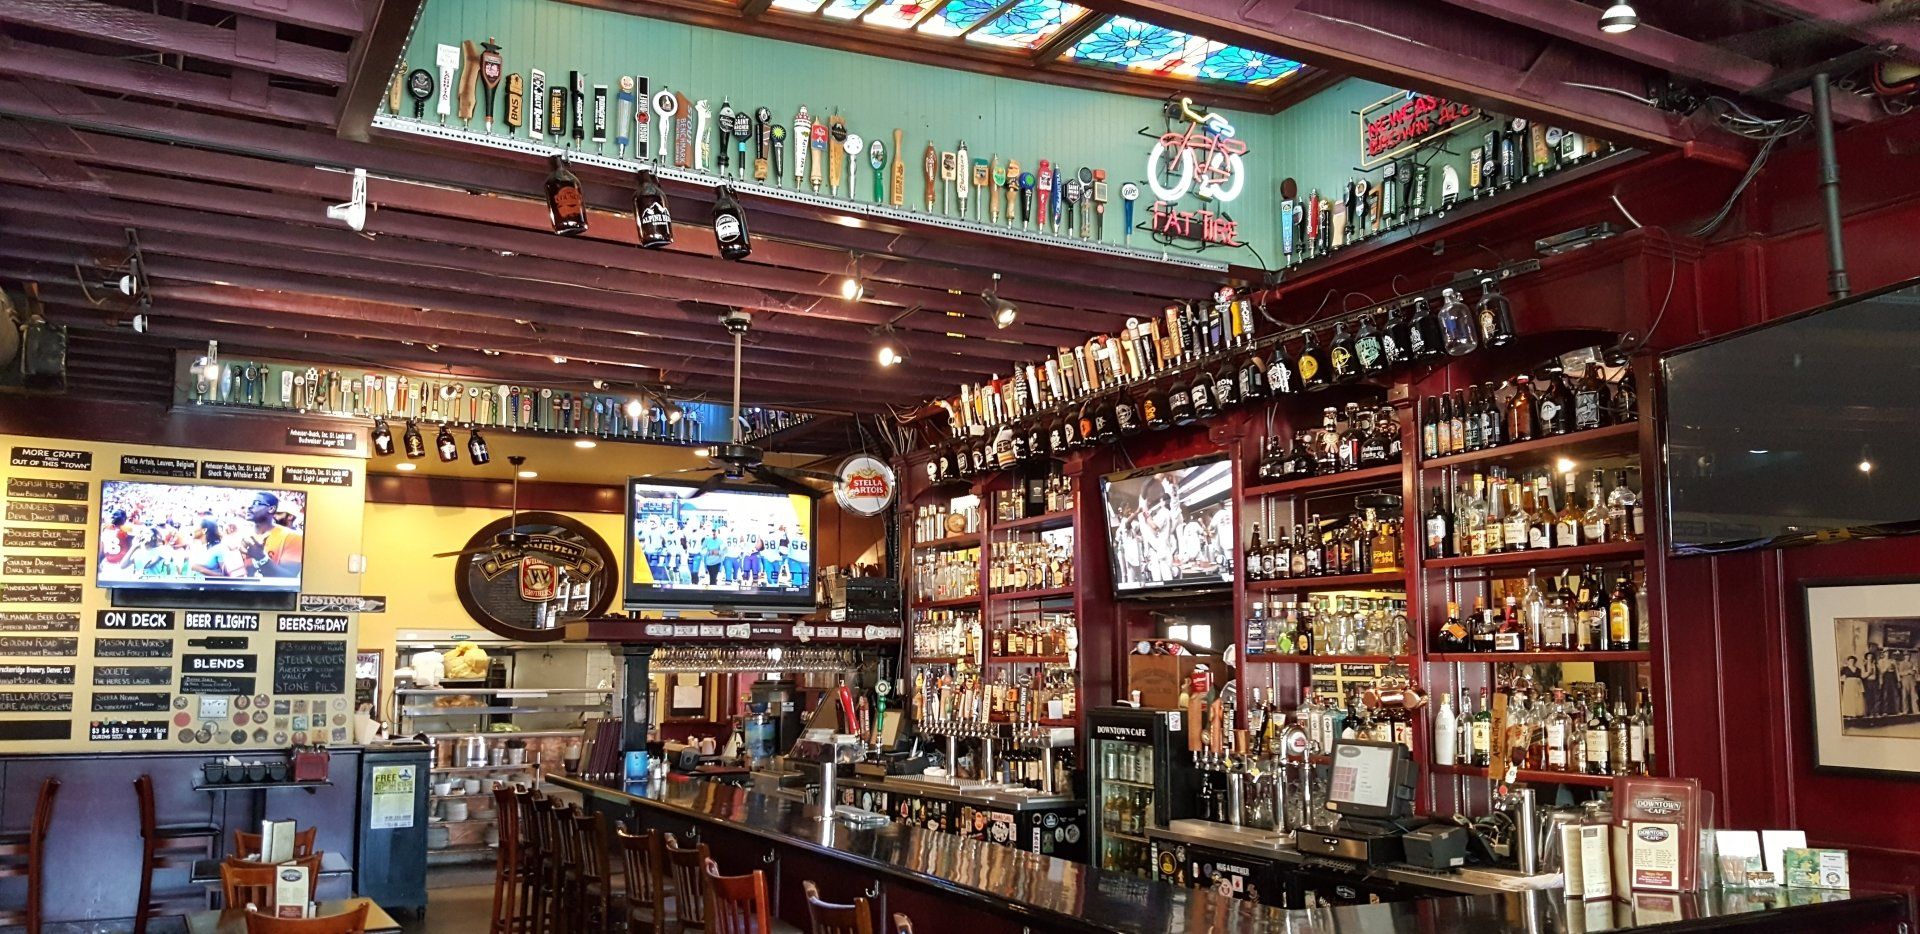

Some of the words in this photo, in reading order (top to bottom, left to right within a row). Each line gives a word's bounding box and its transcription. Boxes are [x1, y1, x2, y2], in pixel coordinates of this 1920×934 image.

[1368, 95, 1446, 138] NEWCAS
[643, 214, 662, 225] ALPINE
[1154, 200, 1194, 236] FAT
[1197, 210, 1242, 246] TIRE
[299, 437, 321, 445] Budweiser
[322, 439, 336, 447] Lager
[22, 449, 49, 457] MORE
[52, 451, 82, 459] CRAFT
[139, 458, 155, 466] Artois,
[157, 459, 175, 467] Leuven,
[176, 460, 195, 469] Belgium
[303, 475, 315, 484] Light
[316, 476, 329, 484] Lager
[855, 486, 884, 494] ARTOIS
[10, 502, 54, 511] FOUNDERS
[791, 541, 807, 550] 68
[301, 596, 363, 605] RESTROOMS
[104, 612, 126, 626] ON
[131, 613, 167, 627] DECK
[186, 613, 211, 628] BEER
[215, 614, 257, 629] FLIGHTS
[279, 618, 313, 631] BEERS
[326, 619, 347, 631] DAY
[193, 658, 244, 668] BLENDS
[278, 655, 312, 665] STELLA
[275, 683, 308, 692] STONE
[315, 681, 337, 691] PILS
[27, 693, 57, 701] ARTOIS
[1097, 726, 1130, 735] DOWNTOWN
[1130, 728, 1146, 736] CAFE
[1396, 726, 1405, 739] 7
[1637, 800, 1680, 809] DOWNTOWN
